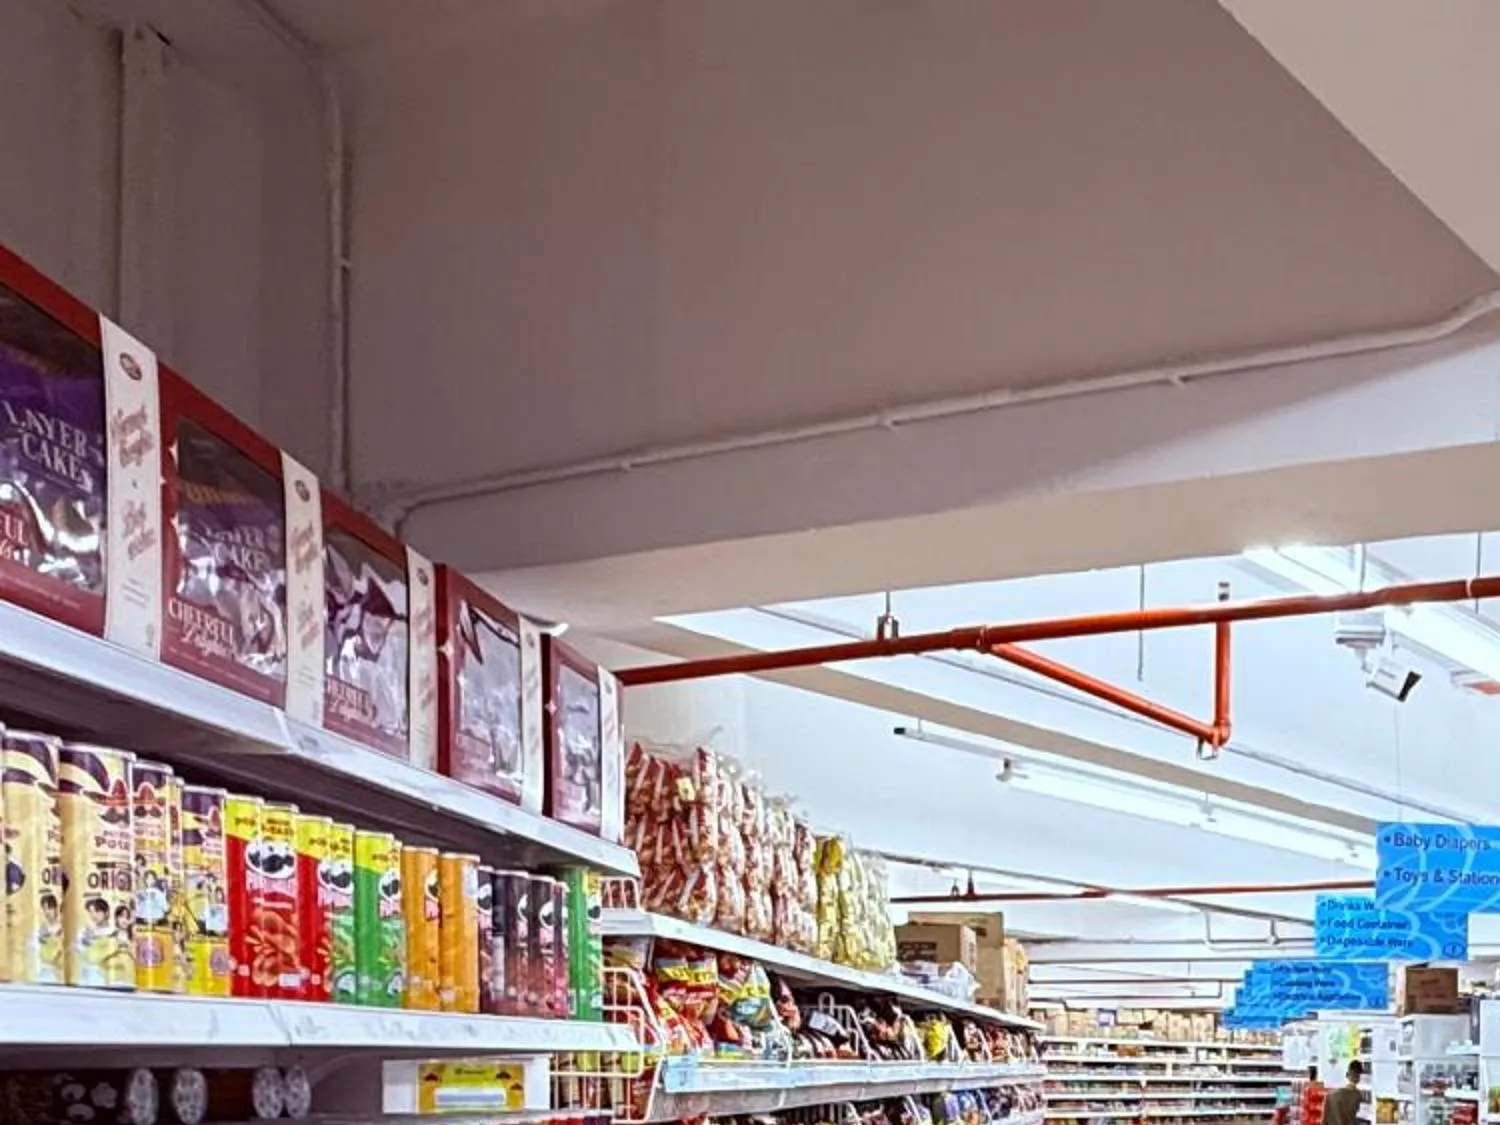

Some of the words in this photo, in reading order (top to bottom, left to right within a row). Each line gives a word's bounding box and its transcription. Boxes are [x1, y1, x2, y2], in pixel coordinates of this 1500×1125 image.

[1393, 833, 1431, 851] Baby
[1435, 834, 1490, 852] Diapers
[1393, 869, 1428, 886] Toys
[1433, 870, 1446, 884] &
